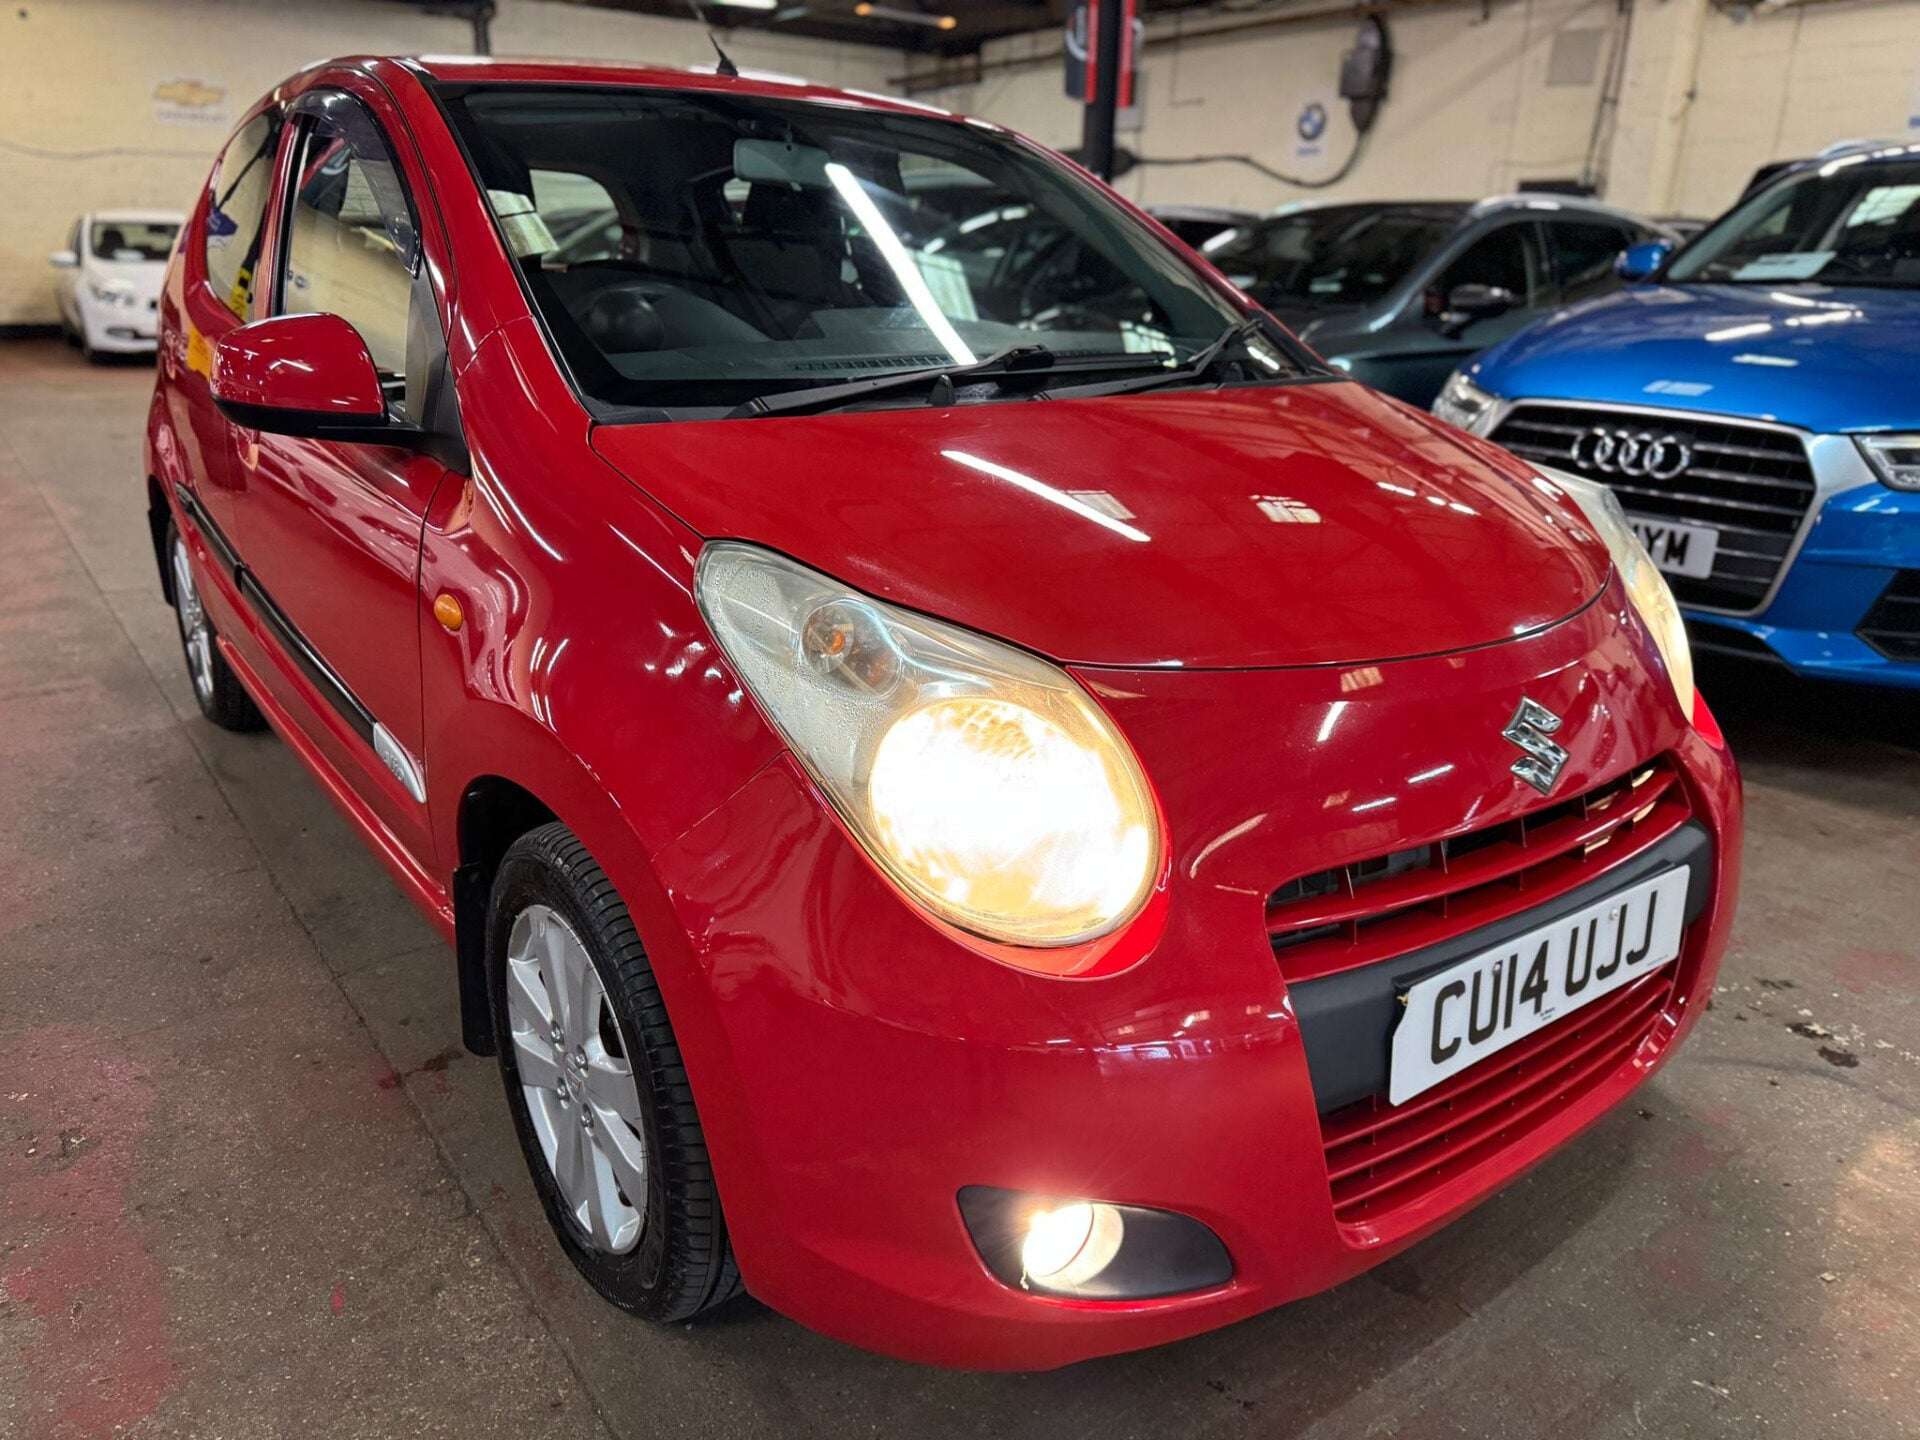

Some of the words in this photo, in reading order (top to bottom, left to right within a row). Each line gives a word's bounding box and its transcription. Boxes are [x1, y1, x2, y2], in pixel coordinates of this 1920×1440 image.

[1632, 525, 1690, 566] YM
[1431, 940, 1549, 1065] CU14
[1565, 890, 1658, 997] UJJ
